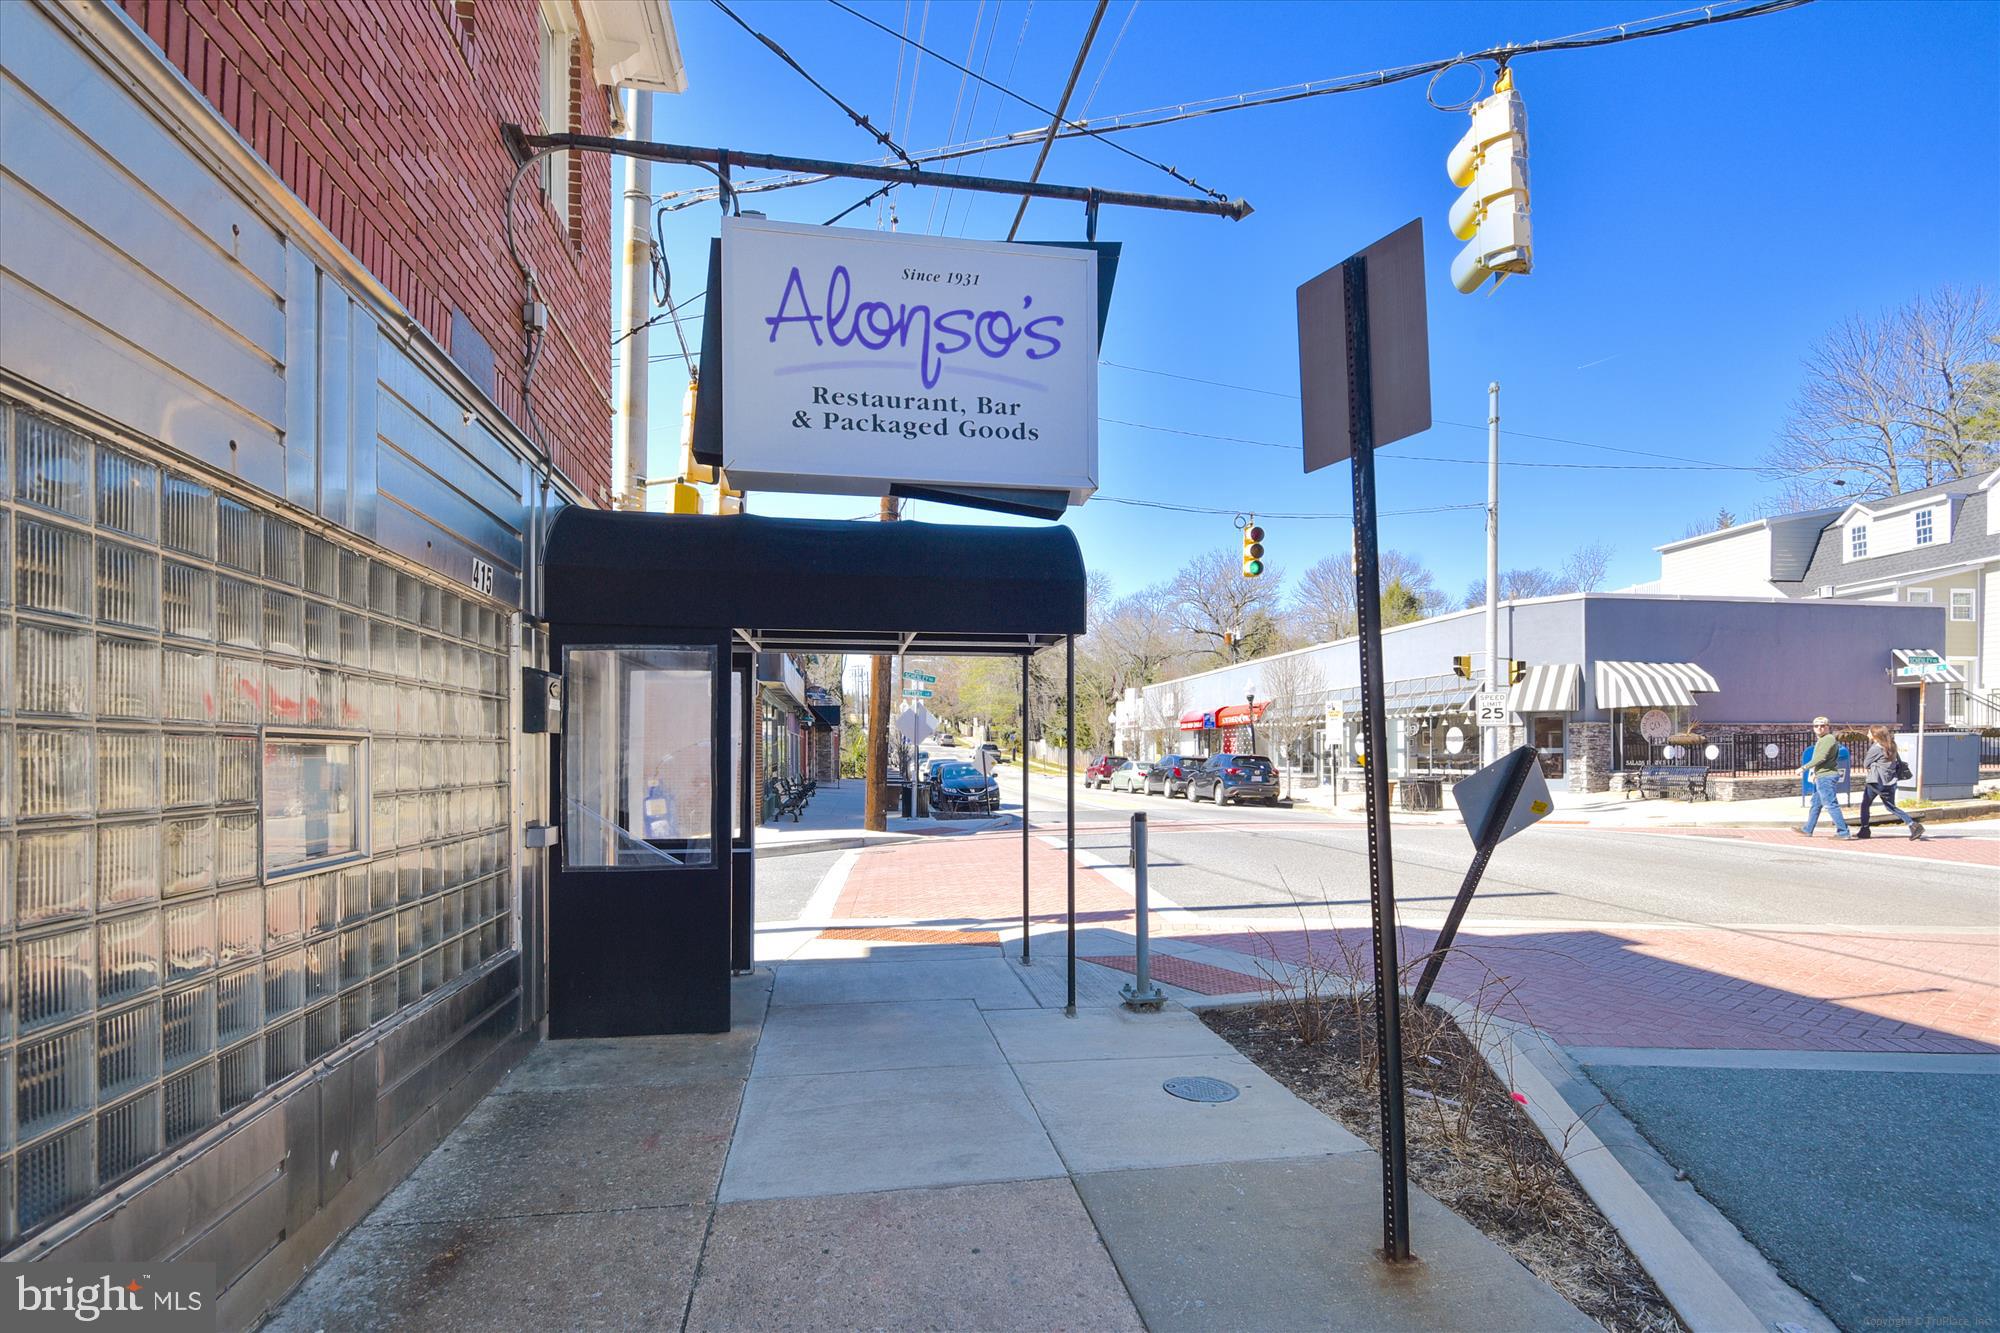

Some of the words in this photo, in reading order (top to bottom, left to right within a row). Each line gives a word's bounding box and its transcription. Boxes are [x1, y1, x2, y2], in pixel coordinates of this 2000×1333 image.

[901, 268, 941, 283] Since
[946, 271, 980, 287] 1931
[765, 265, 1064, 390] Alonso's
[812, 386, 966, 415] Restaurant,
[977, 397, 1021, 416] Bar
[791, 410, 812, 429] &
[823, 412, 949, 440] Packaged
[958, 420, 1039, 441] Goods
[473, 560, 492, 595] 415
[1481, 708, 1504, 719] 25
